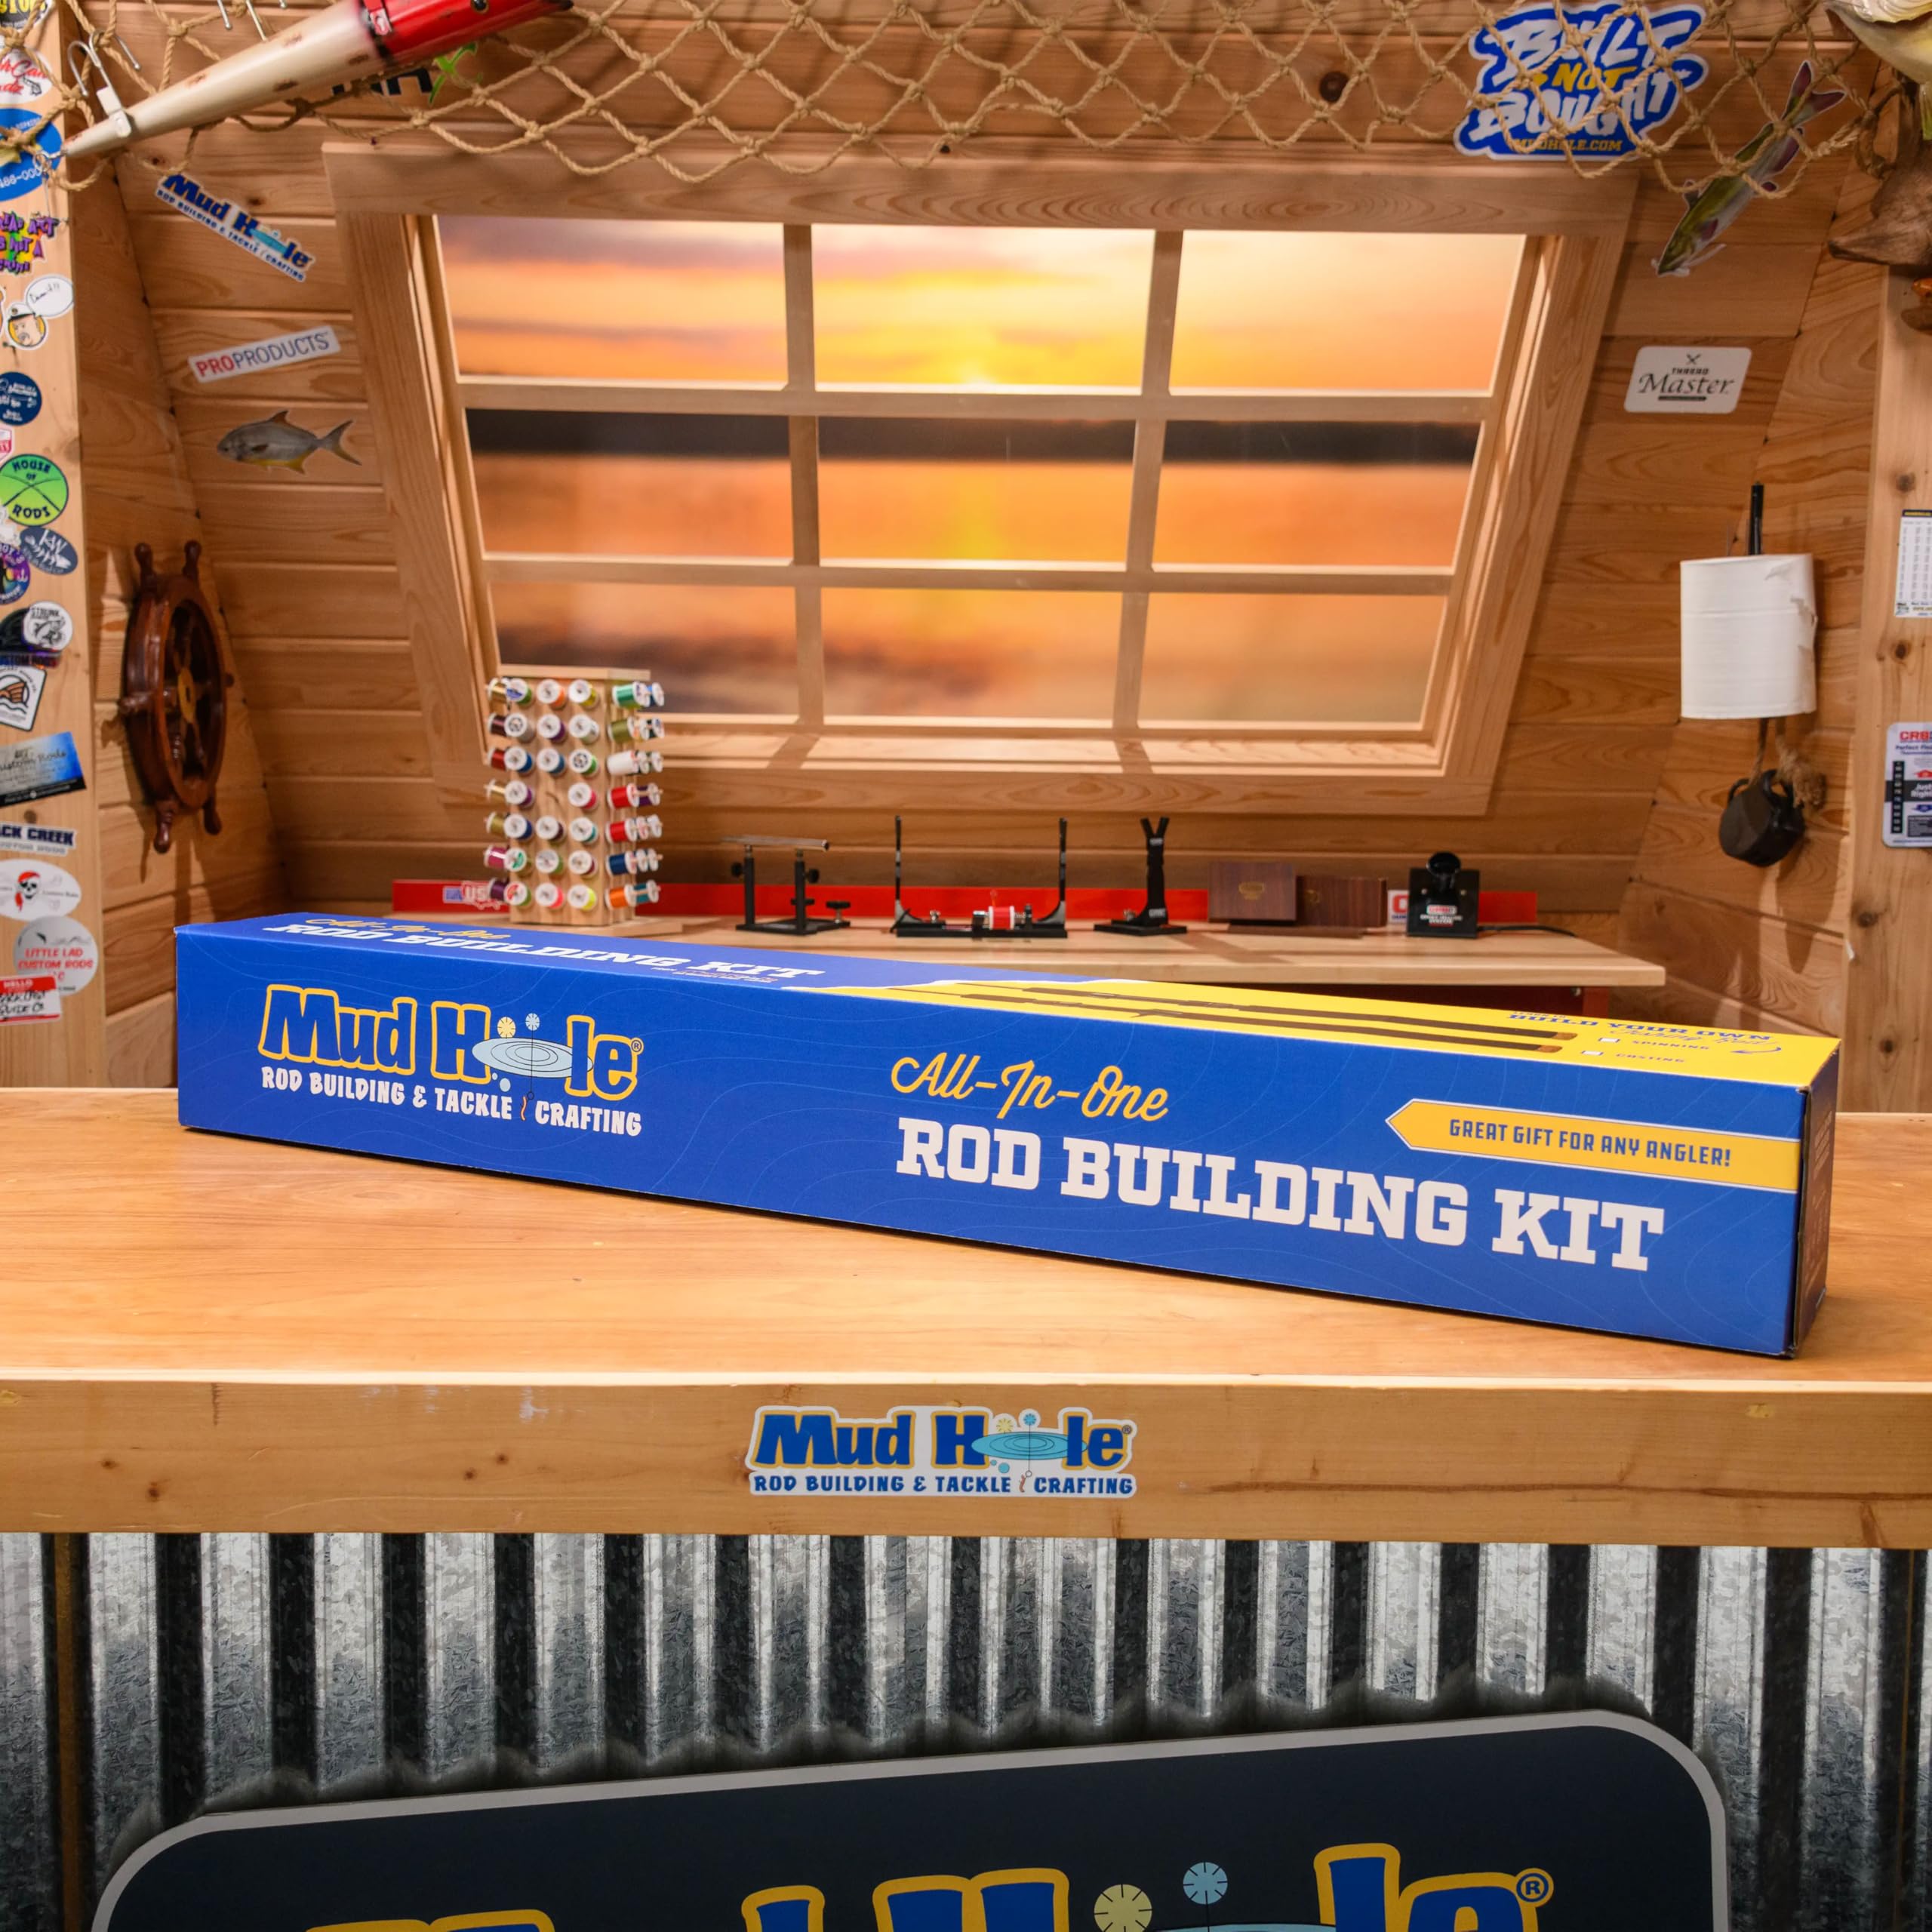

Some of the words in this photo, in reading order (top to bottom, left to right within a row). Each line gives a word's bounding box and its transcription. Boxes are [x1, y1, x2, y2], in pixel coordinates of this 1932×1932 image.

[1552, 63, 1637, 91] NOT
[162, 174, 231, 220] Mud
[178, 202, 217, 228] BUILDING
[228, 232, 259, 252] TACKLE
[265, 254, 304, 280] CRAFTING
[195, 333, 330, 377] PROPRODUCTS
[1638, 374, 1735, 394] Master
[12, 460, 51, 475] HOUSE
[12, 503, 51, 519] RODS
[0, 824, 21, 838] CK
[28, 828, 74, 847] CREEK
[18, 960, 61, 970] CUSTOM
[65, 960, 94, 970] RODS
[24, 948, 59, 958] LITTLE
[383, 935, 691, 967] BUILDING
[687, 961, 826, 978] KIT
[258, 984, 417, 1075] Mud
[1509, 1014, 1598, 1026] BUILD
[1607, 1023, 1688, 1033] YOUR
[1696, 1031, 1771, 1041] OWN
[261, 1066, 303, 1091] ROD
[309, 1072, 406, 1105] BUILDING
[413, 1084, 427, 1108] &
[435, 1088, 512, 1121] TACKLE
[534, 1103, 642, 1137] CRAFTING
[891, 1052, 1169, 1121] All-In-One
[1449, 1118, 1509, 1142] GREAT
[1512, 1126, 1553, 1148] GIFT
[1558, 1129, 1595, 1152] FOR
[1600, 1135, 1640, 1157] ANY
[1646, 1140, 1731, 1168] ANGLER!
[896, 1117, 1041, 1190] ROD
[1060, 1137, 1468, 1247] BUILDING
[1491, 1188, 1665, 1272] KIT
[754, 1409, 916, 1469] Mud
[754, 1475, 797, 1492] ROD
[805, 1475, 905, 1494] BUILDING
[913, 1475, 927, 1492] &
[936, 1475, 1011, 1494] TACKLE
[1033, 1477, 1133, 1495] CRAFTING
